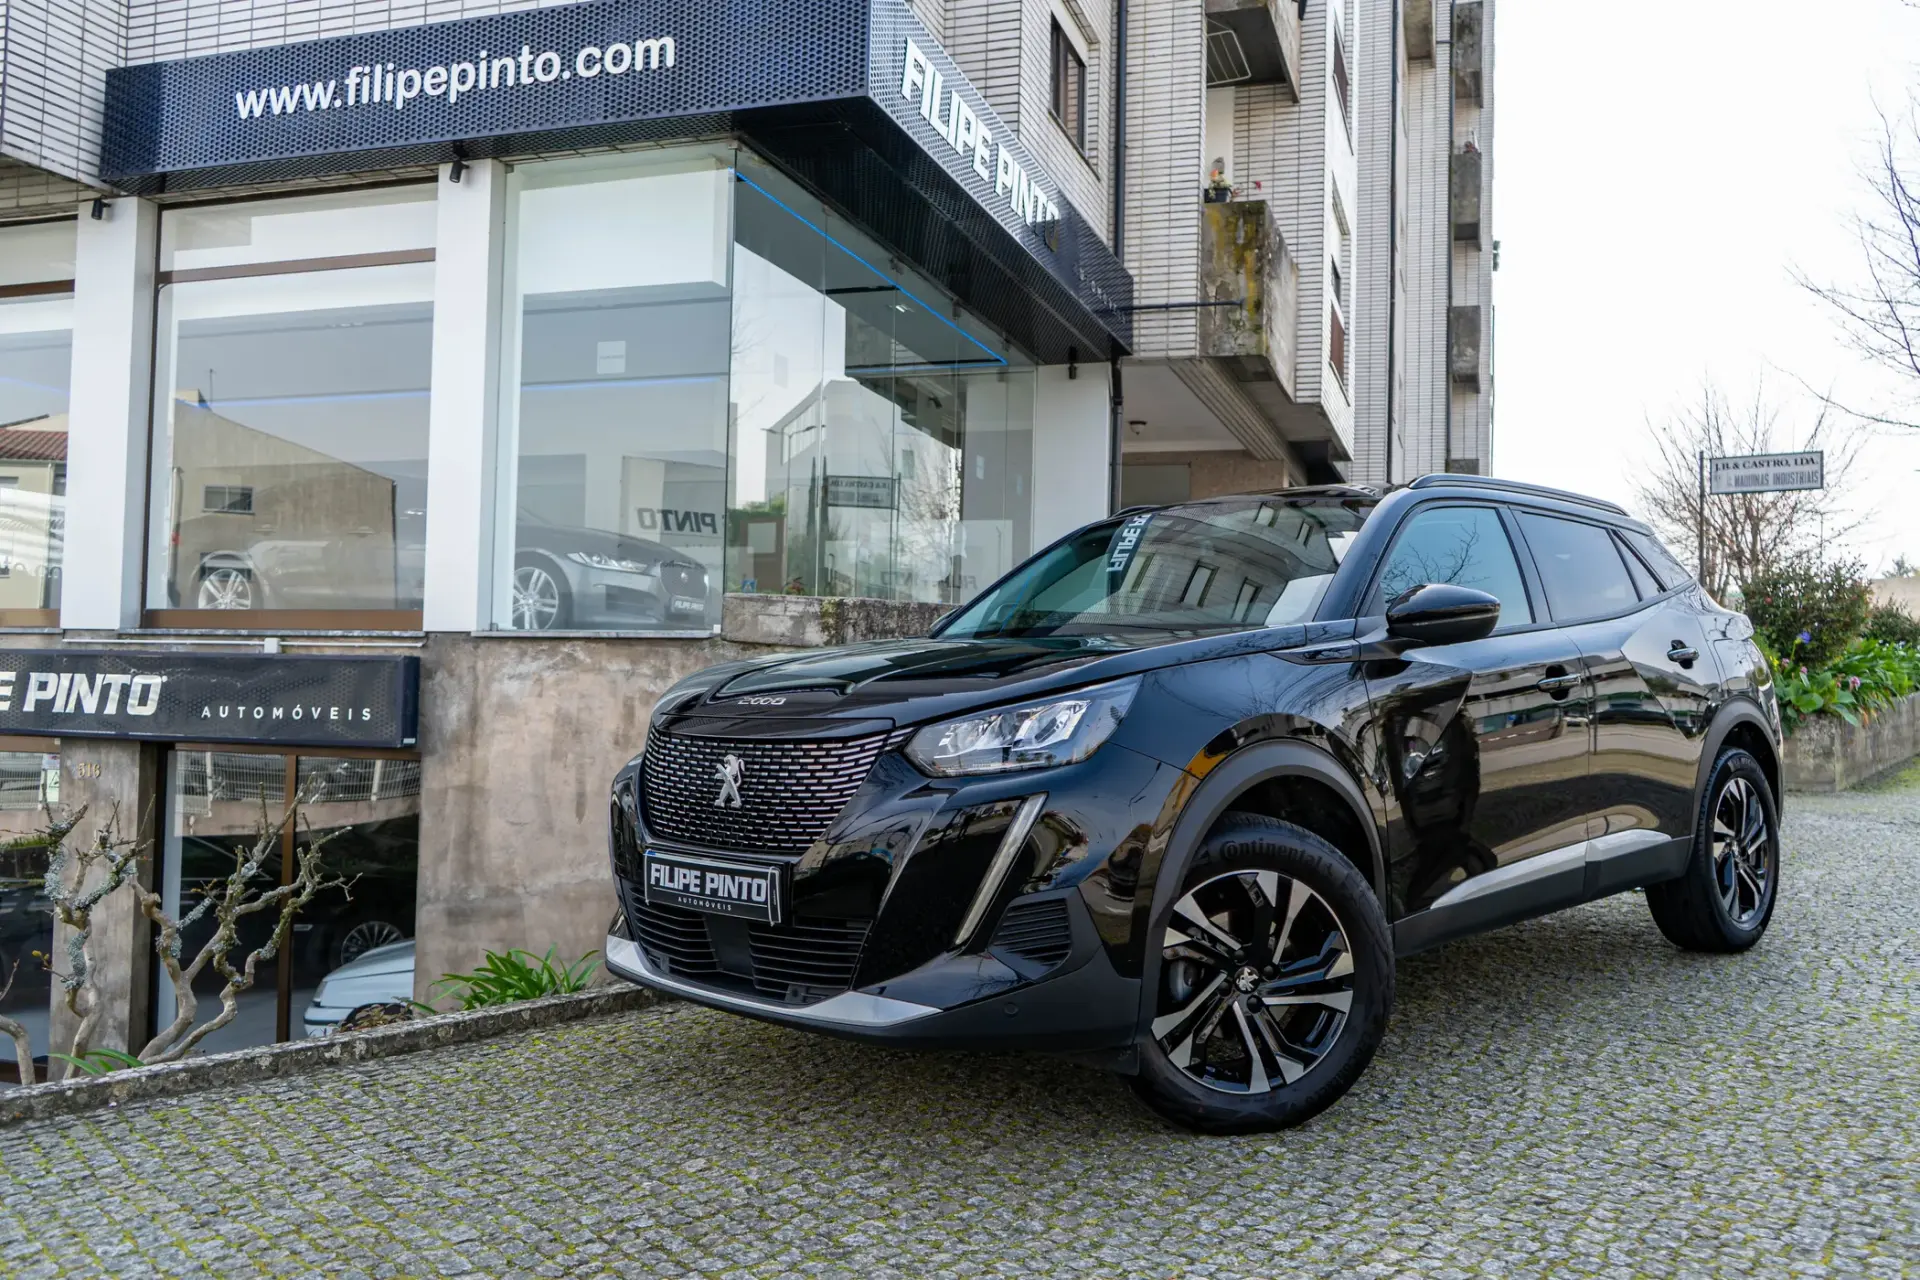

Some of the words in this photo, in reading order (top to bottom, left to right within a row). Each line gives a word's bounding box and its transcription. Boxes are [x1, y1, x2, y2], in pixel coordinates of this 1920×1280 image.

[235, 36, 676, 119] www.filipepinto.com
[901, 36, 993, 182] FILIPE
[994, 143, 1060, 252] PINTO
[23, 673, 165, 716] PINTO
[201, 704, 372, 721] AUTOMÓVEIS
[78, 762, 101, 779] 516
[1220, 838, 1323, 871] Continental
[650, 863, 701, 893] FILIPE
[705, 872, 768, 902] PINTO
[677, 896, 733, 912] AUTOMÓVEIS
